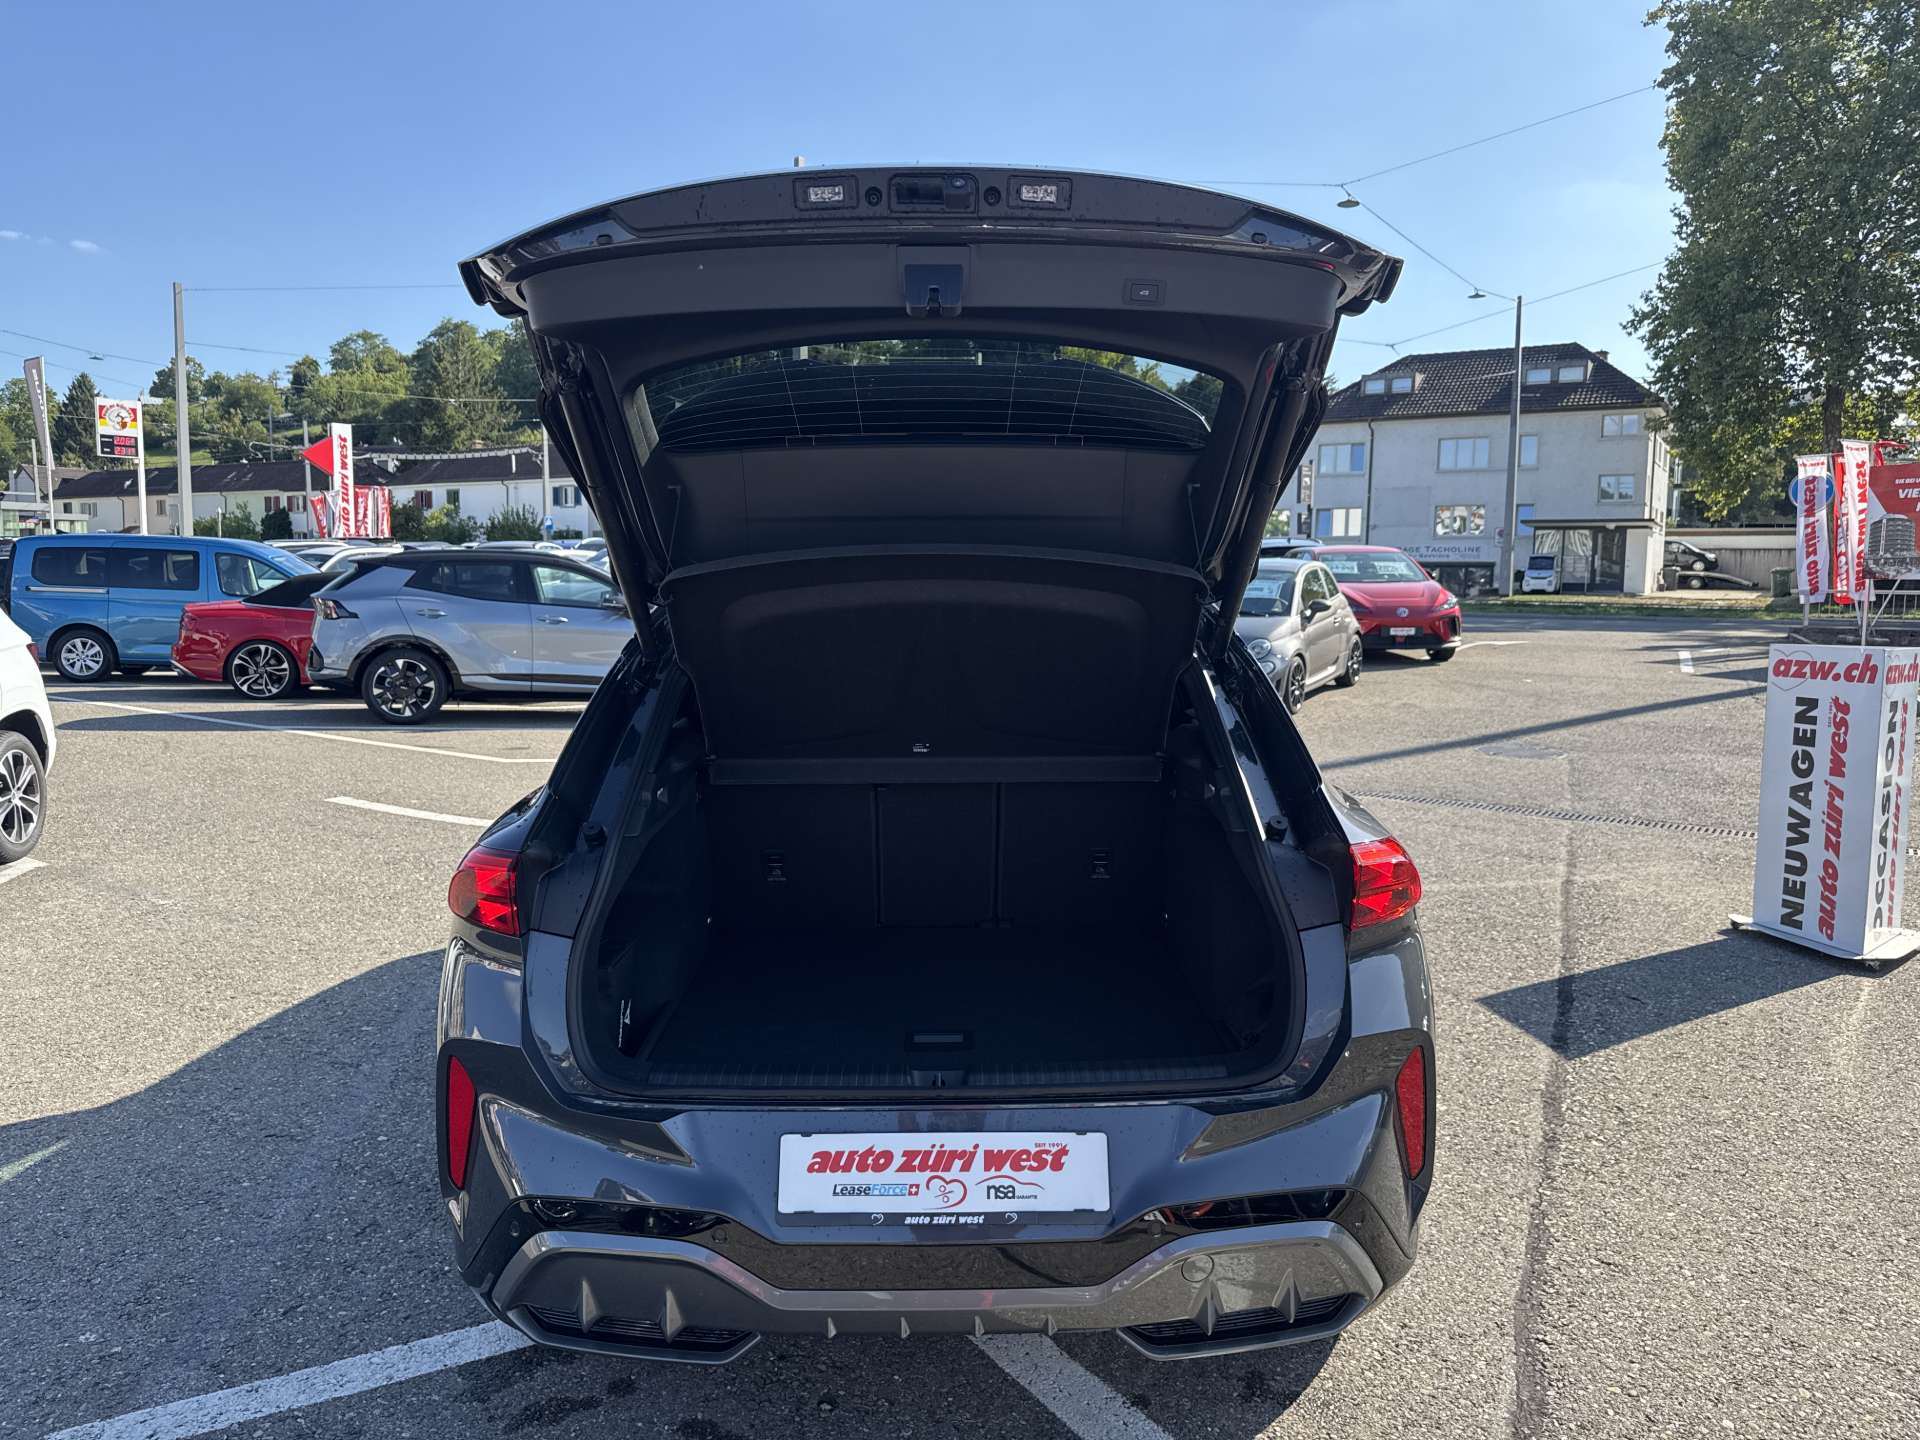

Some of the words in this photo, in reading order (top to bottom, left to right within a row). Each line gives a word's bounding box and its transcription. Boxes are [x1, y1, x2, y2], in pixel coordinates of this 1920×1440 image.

[1772, 653, 1879, 684] azw.ch
[1885, 653, 1920, 685] azw.ch
[1829, 695, 1851, 778] west
[1780, 696, 1819, 931] NEUWAGEN
[1822, 779, 1845, 861] züri
[1816, 858, 1839, 942] auto
[806, 1144, 894, 1174] auto
[895, 1143, 979, 1173] züri
[983, 1143, 1070, 1173] west
[832, 1183, 908, 1197] LeaseForce
[986, 1184, 1016, 1200] nsa
[904, 1215, 931, 1224] auto
[932, 1214, 957, 1224] züri
[958, 1214, 985, 1224] west
